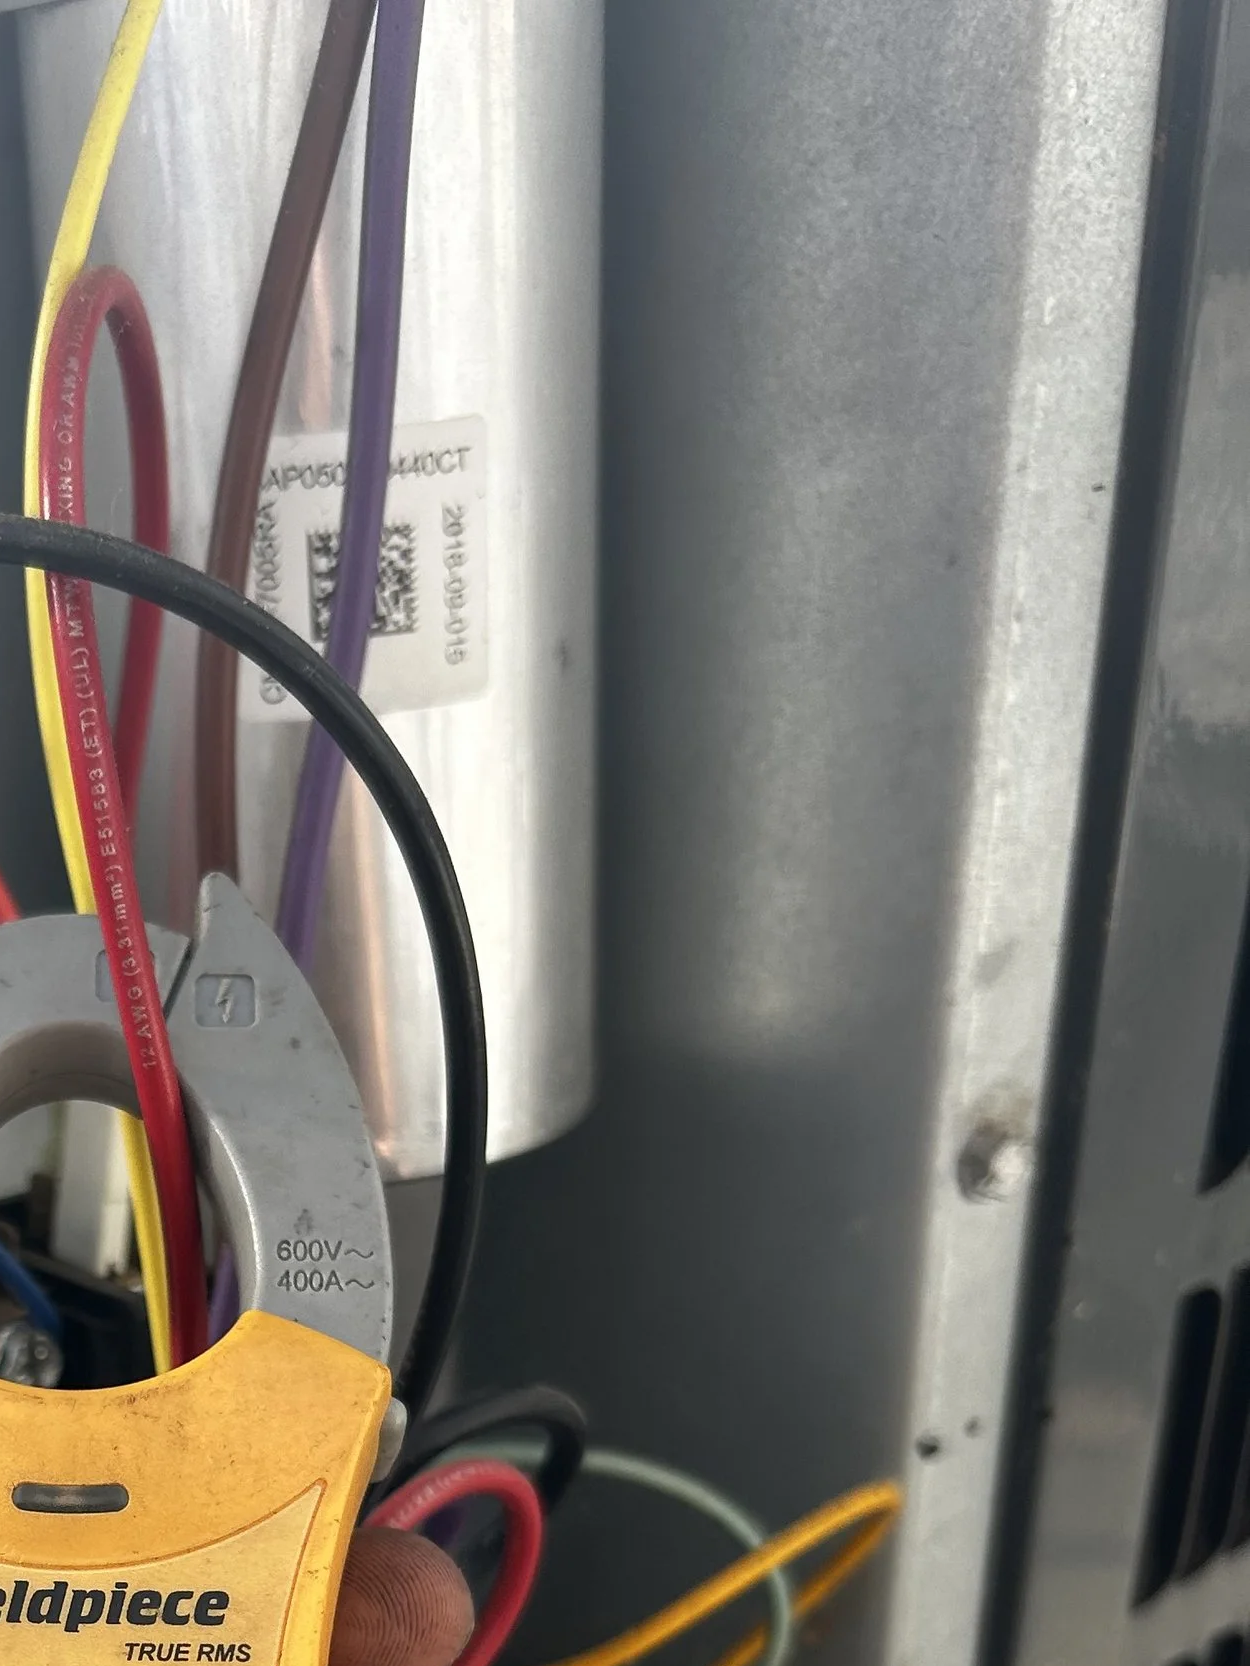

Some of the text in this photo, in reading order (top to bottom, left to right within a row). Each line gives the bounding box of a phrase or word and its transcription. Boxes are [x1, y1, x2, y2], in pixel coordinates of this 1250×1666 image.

[127, 984, 153, 1040] AWG
[124, 1642, 252, 1664] TRUE RMS
